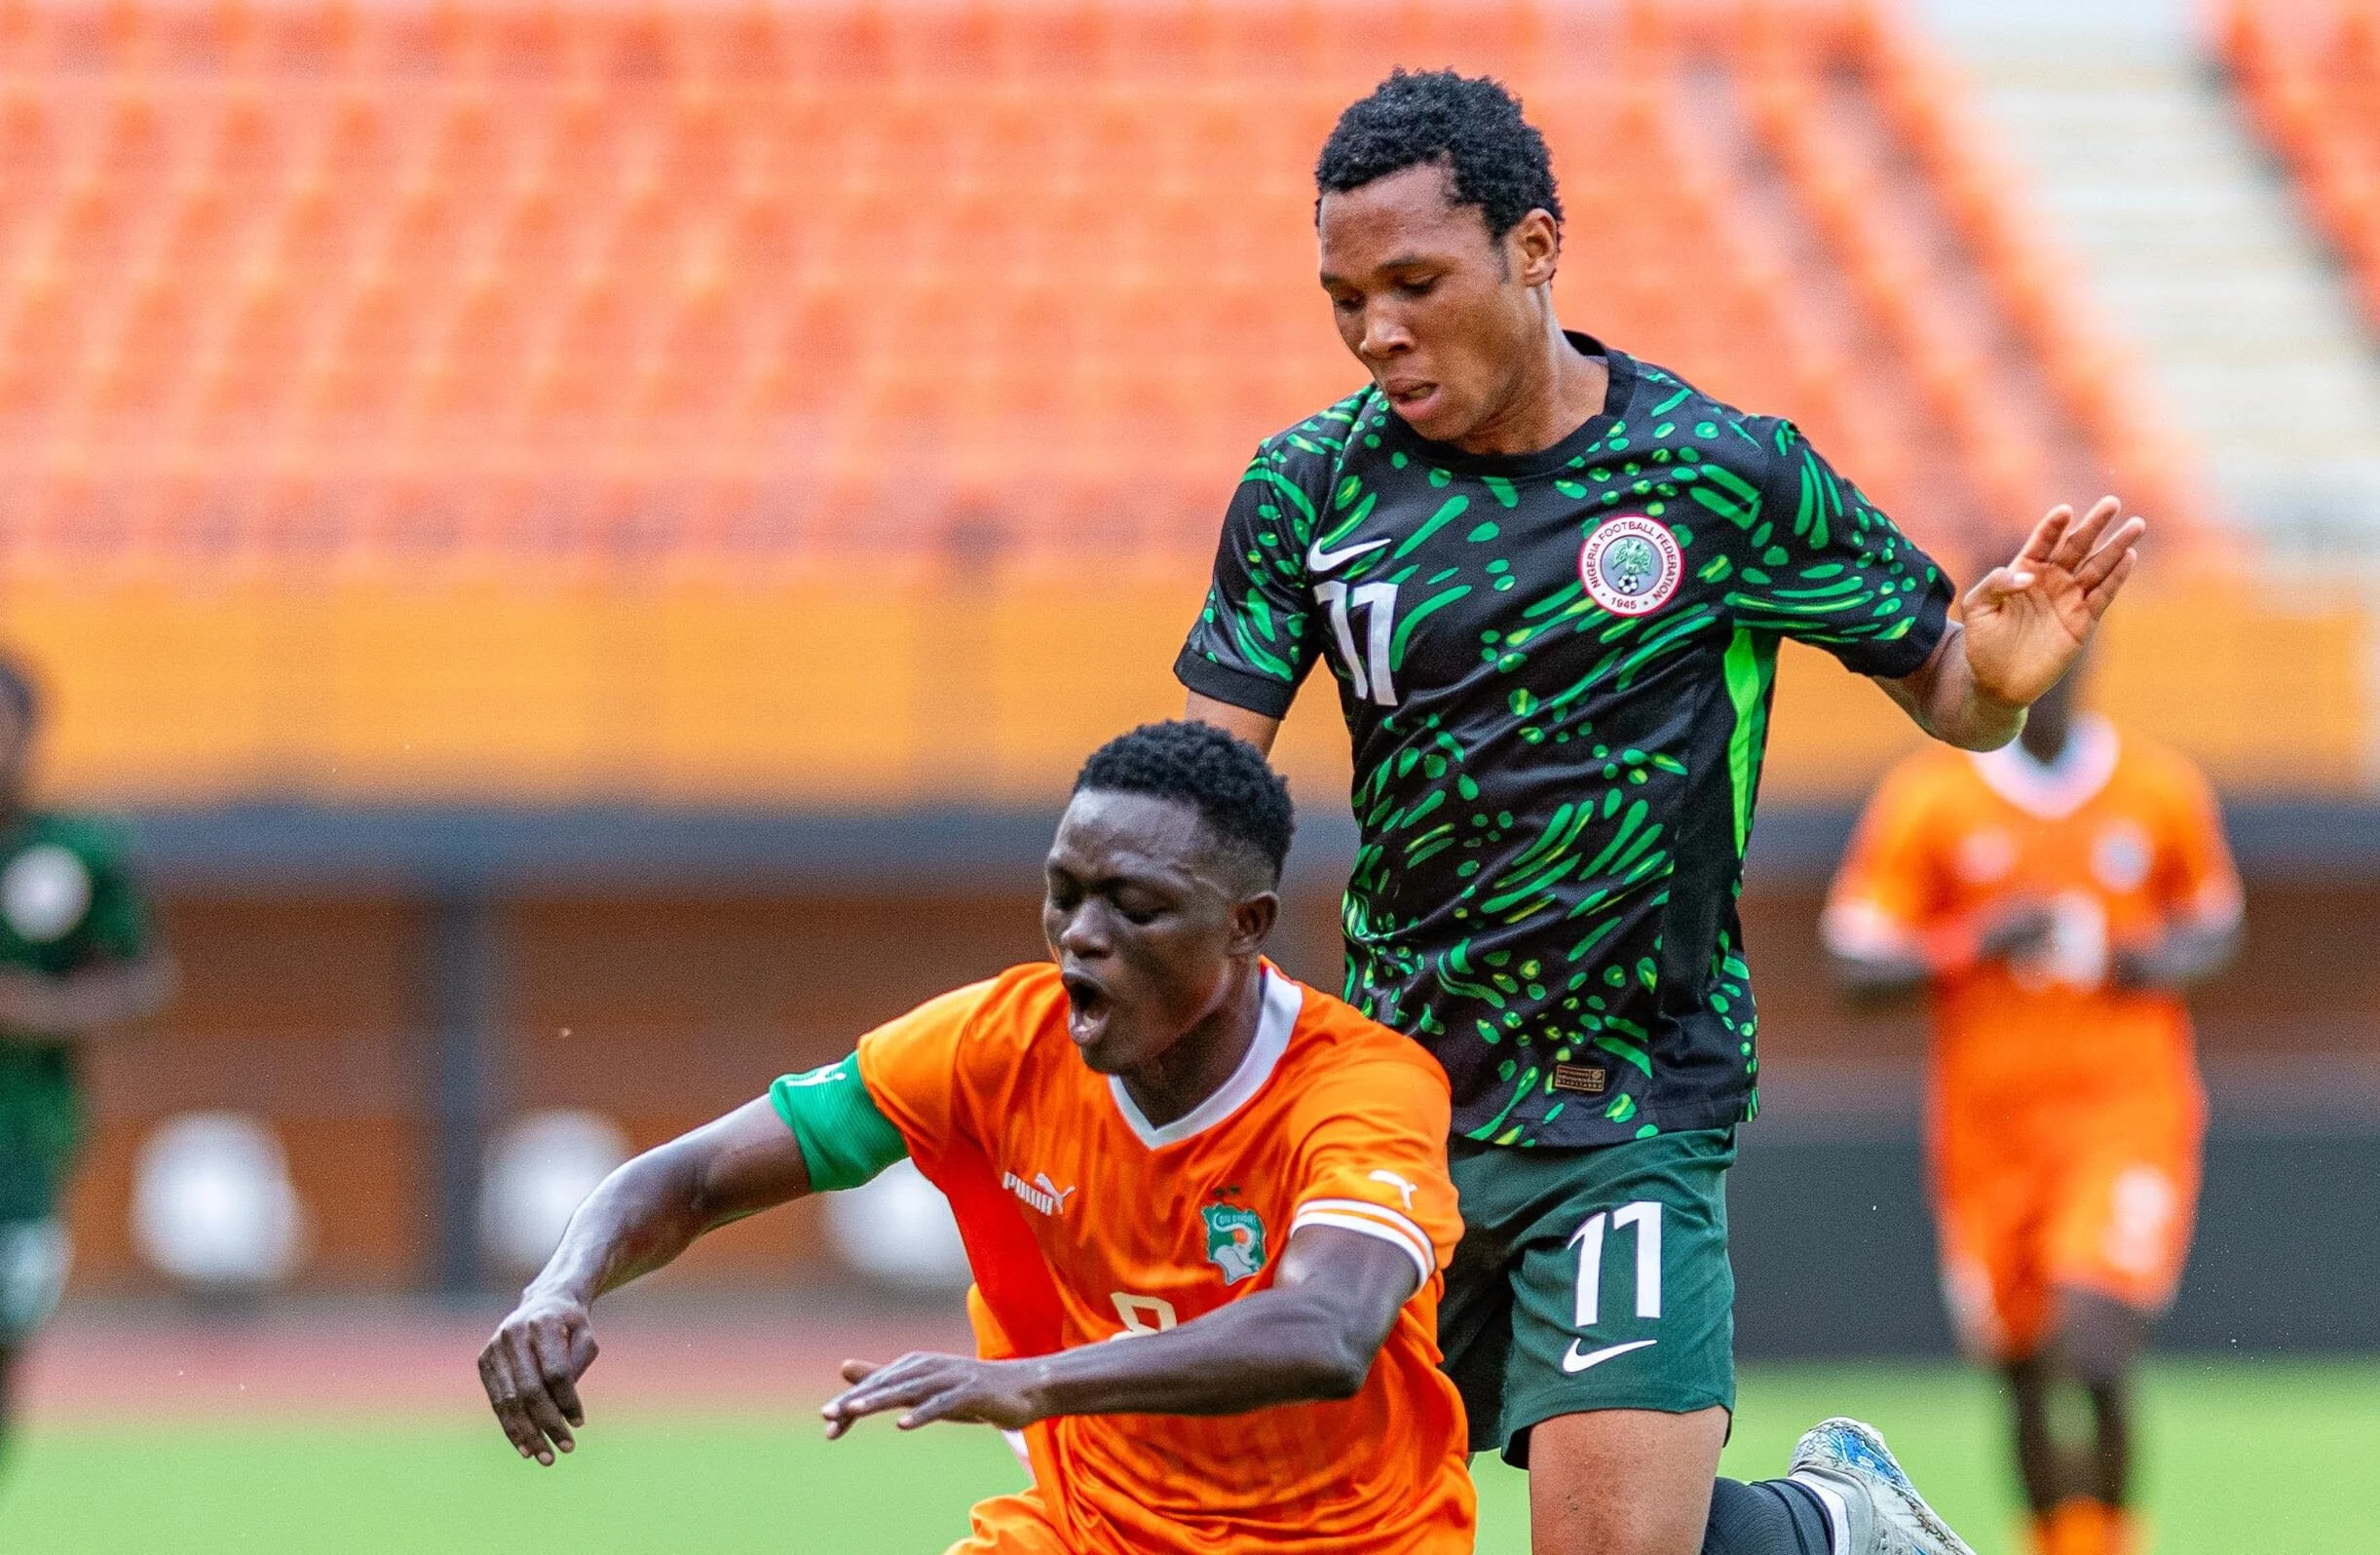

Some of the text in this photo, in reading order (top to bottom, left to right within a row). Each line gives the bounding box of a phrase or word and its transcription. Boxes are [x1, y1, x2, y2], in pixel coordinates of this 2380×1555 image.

[1586, 520, 1678, 602] NIGERIA FOOTBALL FEDERATION
[1312, 580, 1399, 706] 11
[1610, 596, 1638, 610] 1945
[1001, 1170, 1054, 1217] PUMA
[1567, 1200, 1663, 1328] 11
